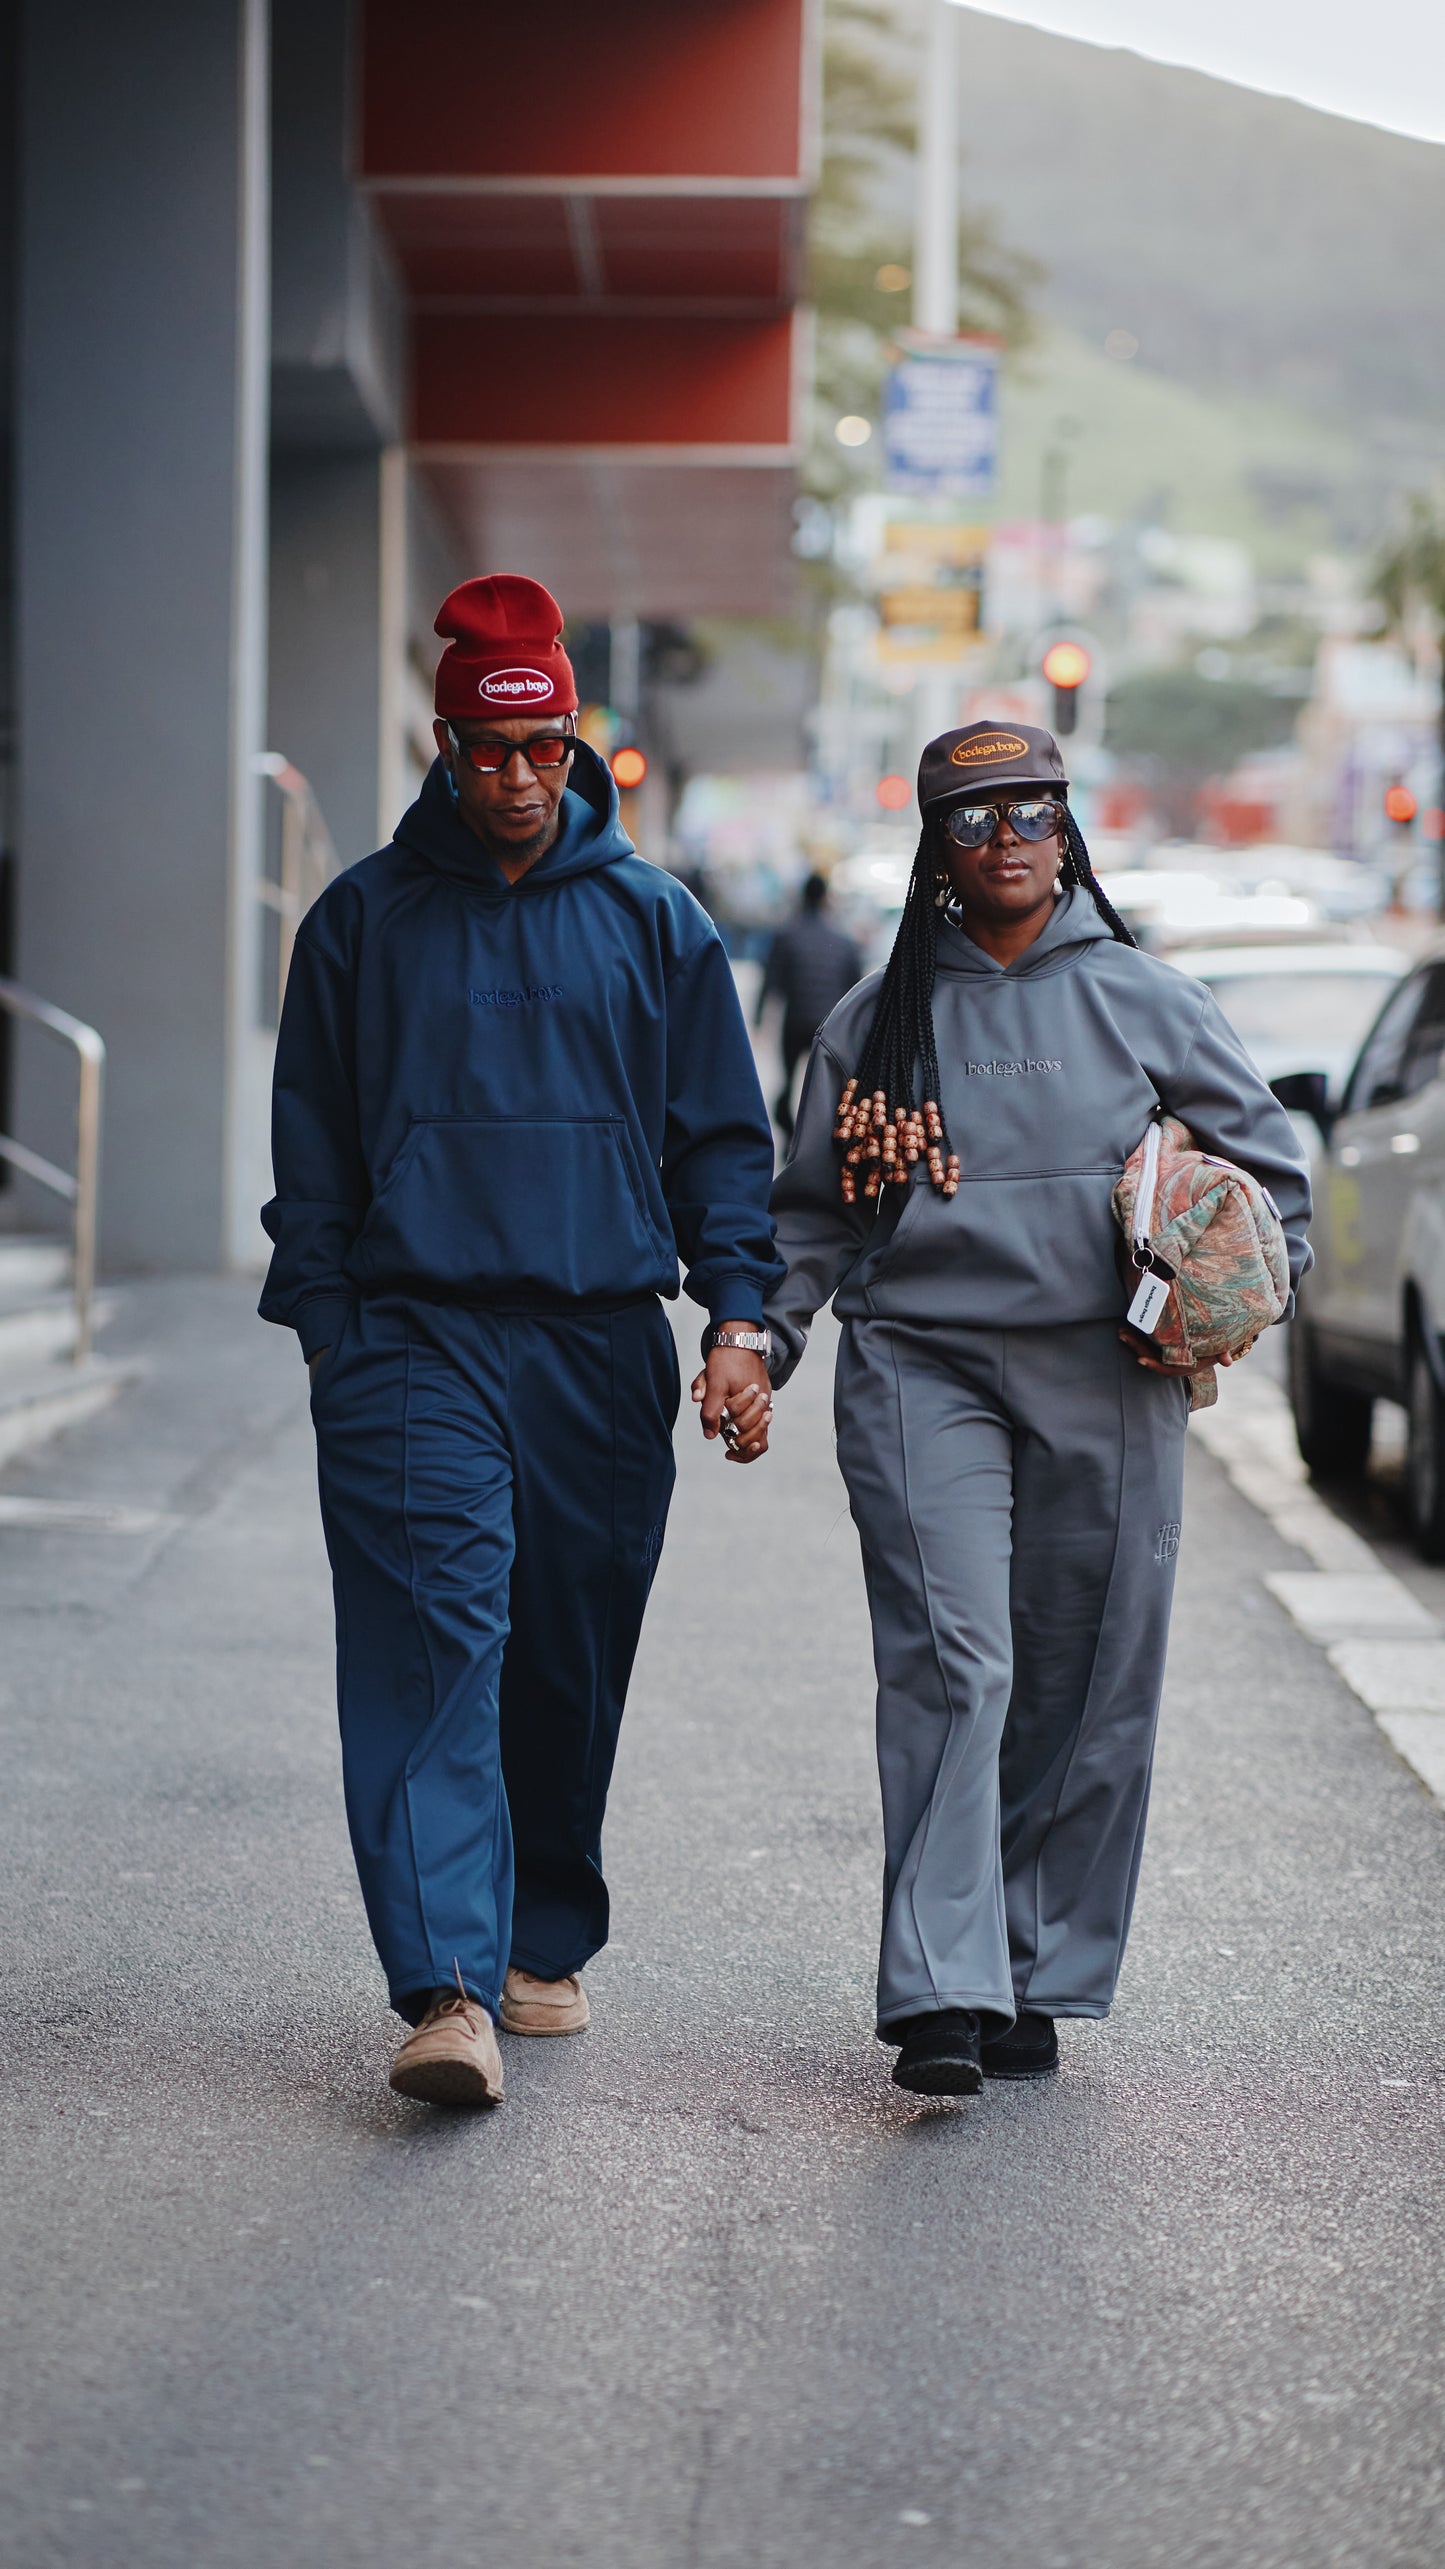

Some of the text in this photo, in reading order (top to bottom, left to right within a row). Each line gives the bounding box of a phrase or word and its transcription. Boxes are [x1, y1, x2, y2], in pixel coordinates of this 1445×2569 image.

[485, 678, 549, 695] bodega boys
[958, 741, 1022, 760] bodega boys
[468, 985, 564, 1007] bodega boys
[965, 1058, 1063, 1077] bodega boys
